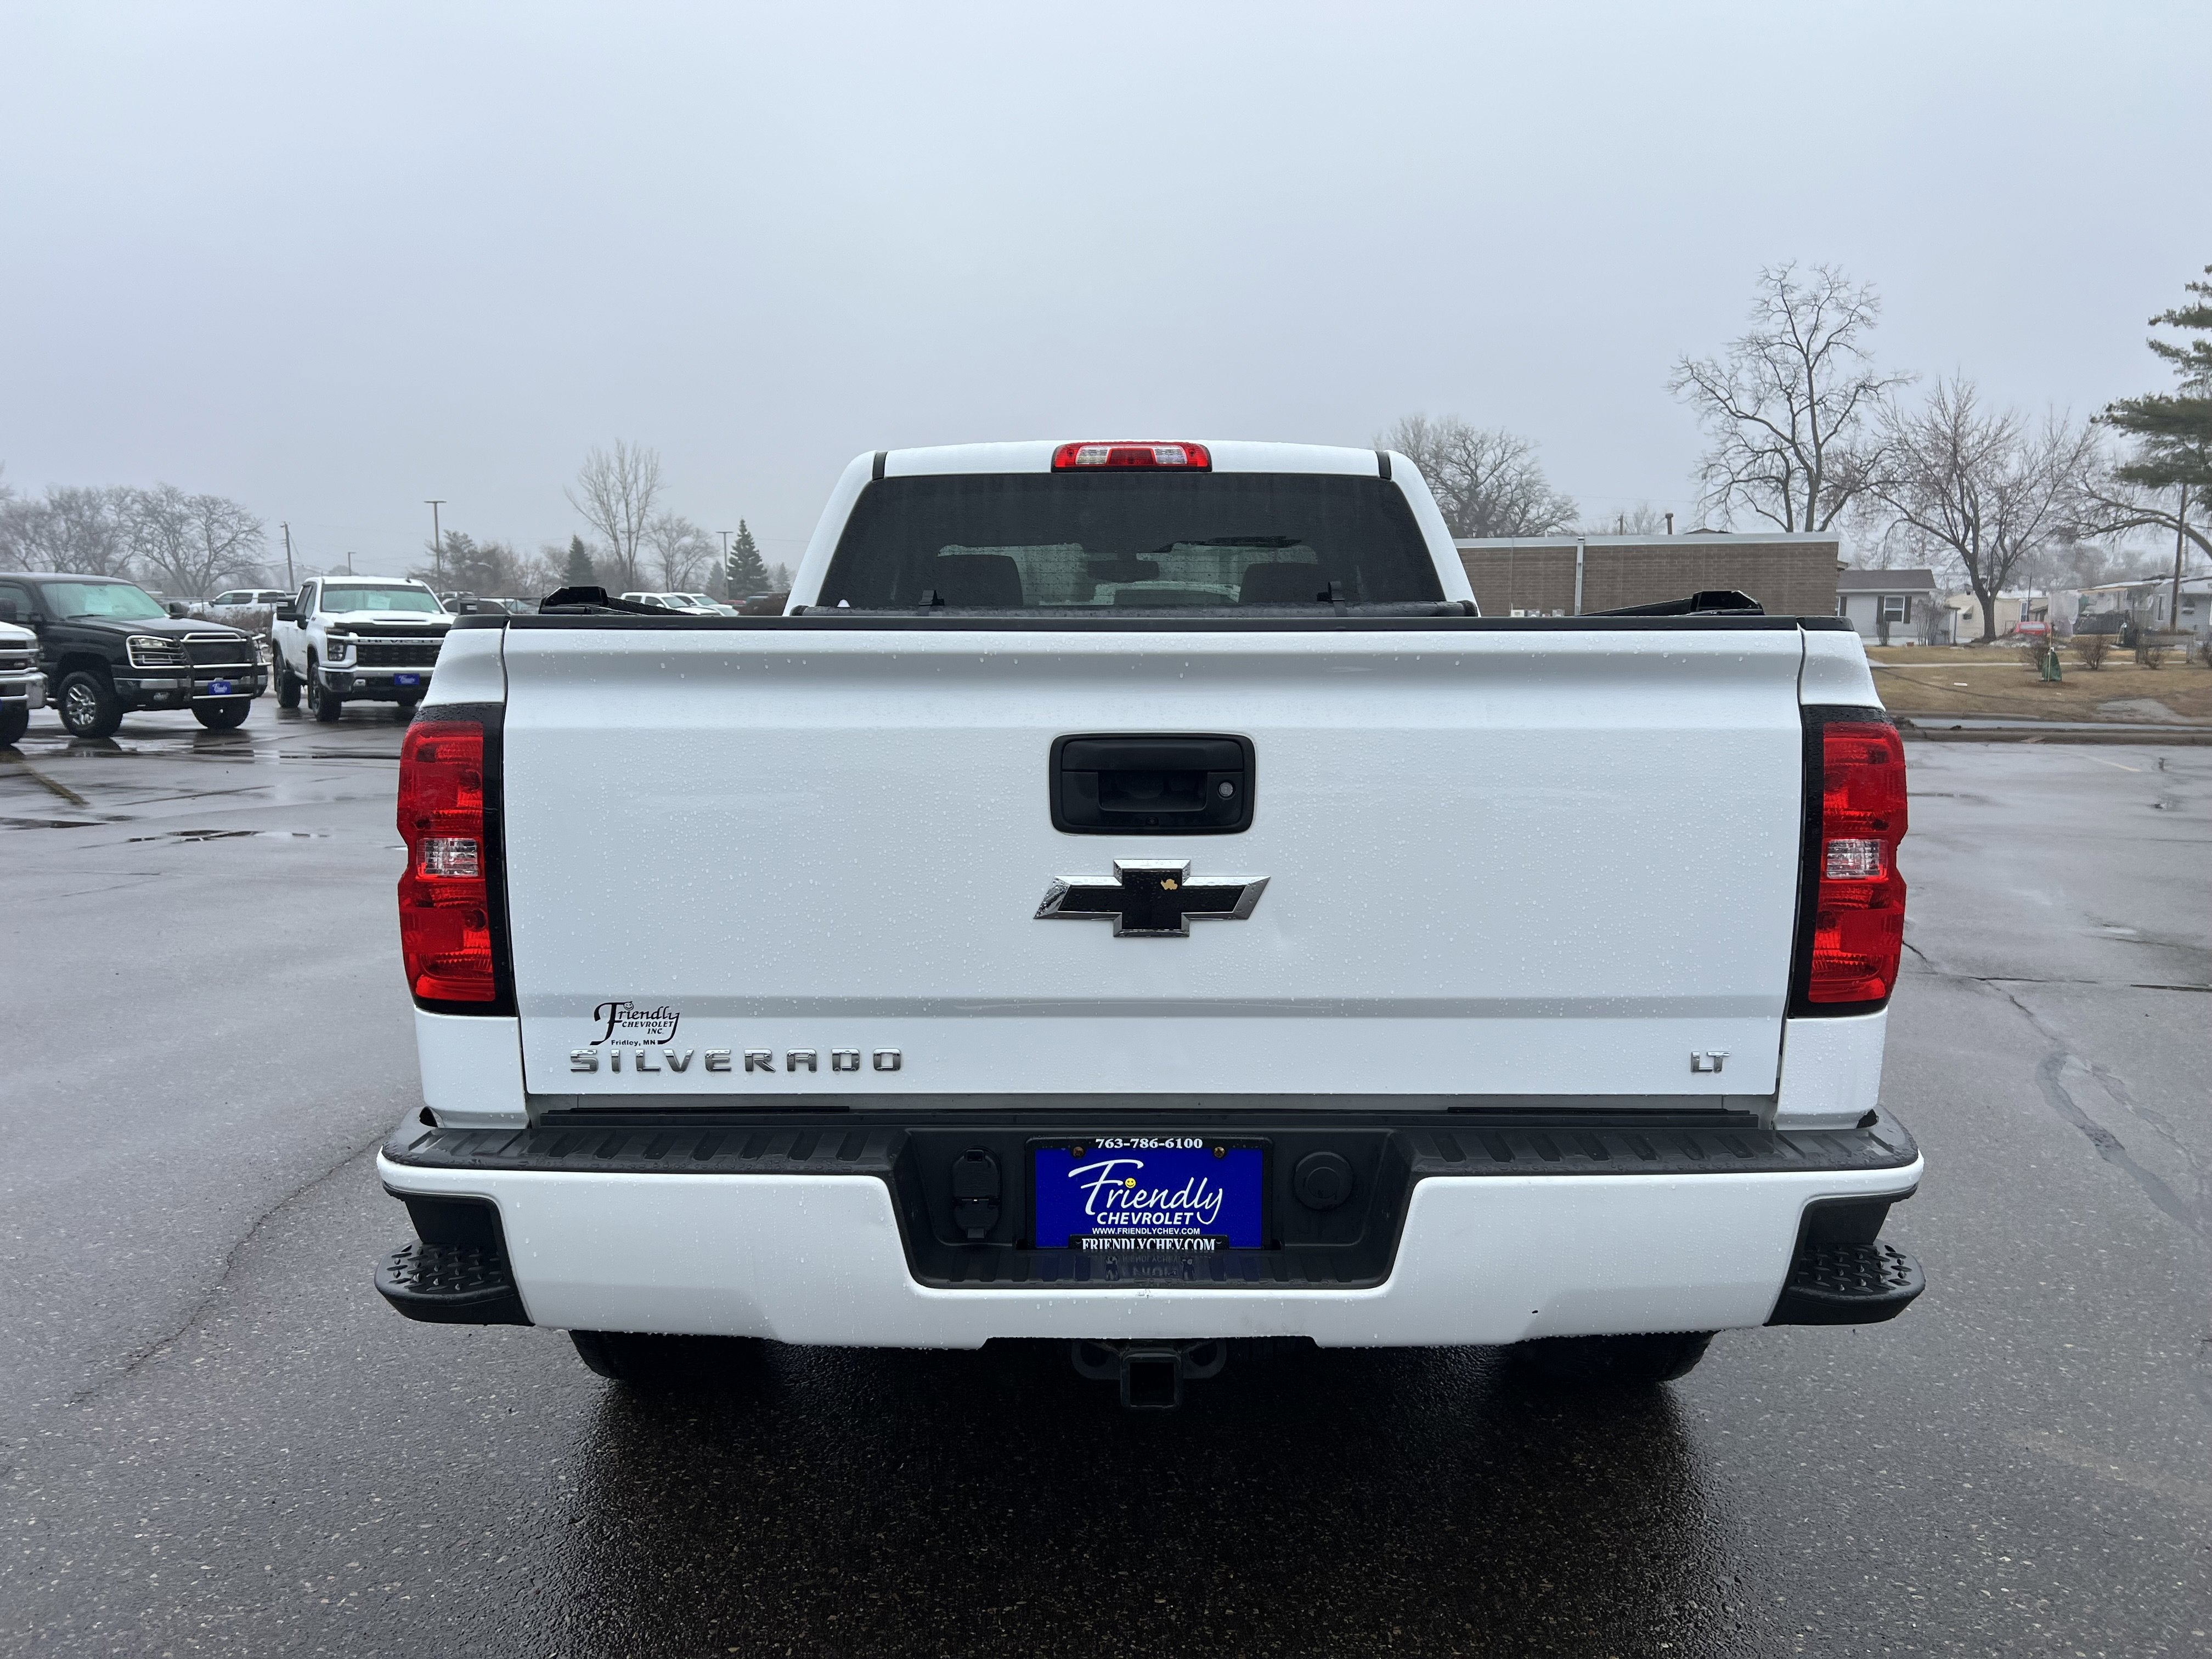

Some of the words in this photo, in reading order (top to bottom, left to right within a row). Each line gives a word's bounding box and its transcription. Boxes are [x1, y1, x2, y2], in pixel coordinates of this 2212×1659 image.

[590, 1001, 680, 1046] Friendly
[571, 1048, 901, 1072] SILVERADO
[1690, 1051, 1730, 1073] LT
[1096, 1138, 1203, 1149] 763-786-6100
[1068, 1159, 1223, 1224] Friendly
[1097, 1212, 1194, 1225] CHEVROLET
[1082, 1238, 1216, 1251] FRIENDLYCHEV.COM
